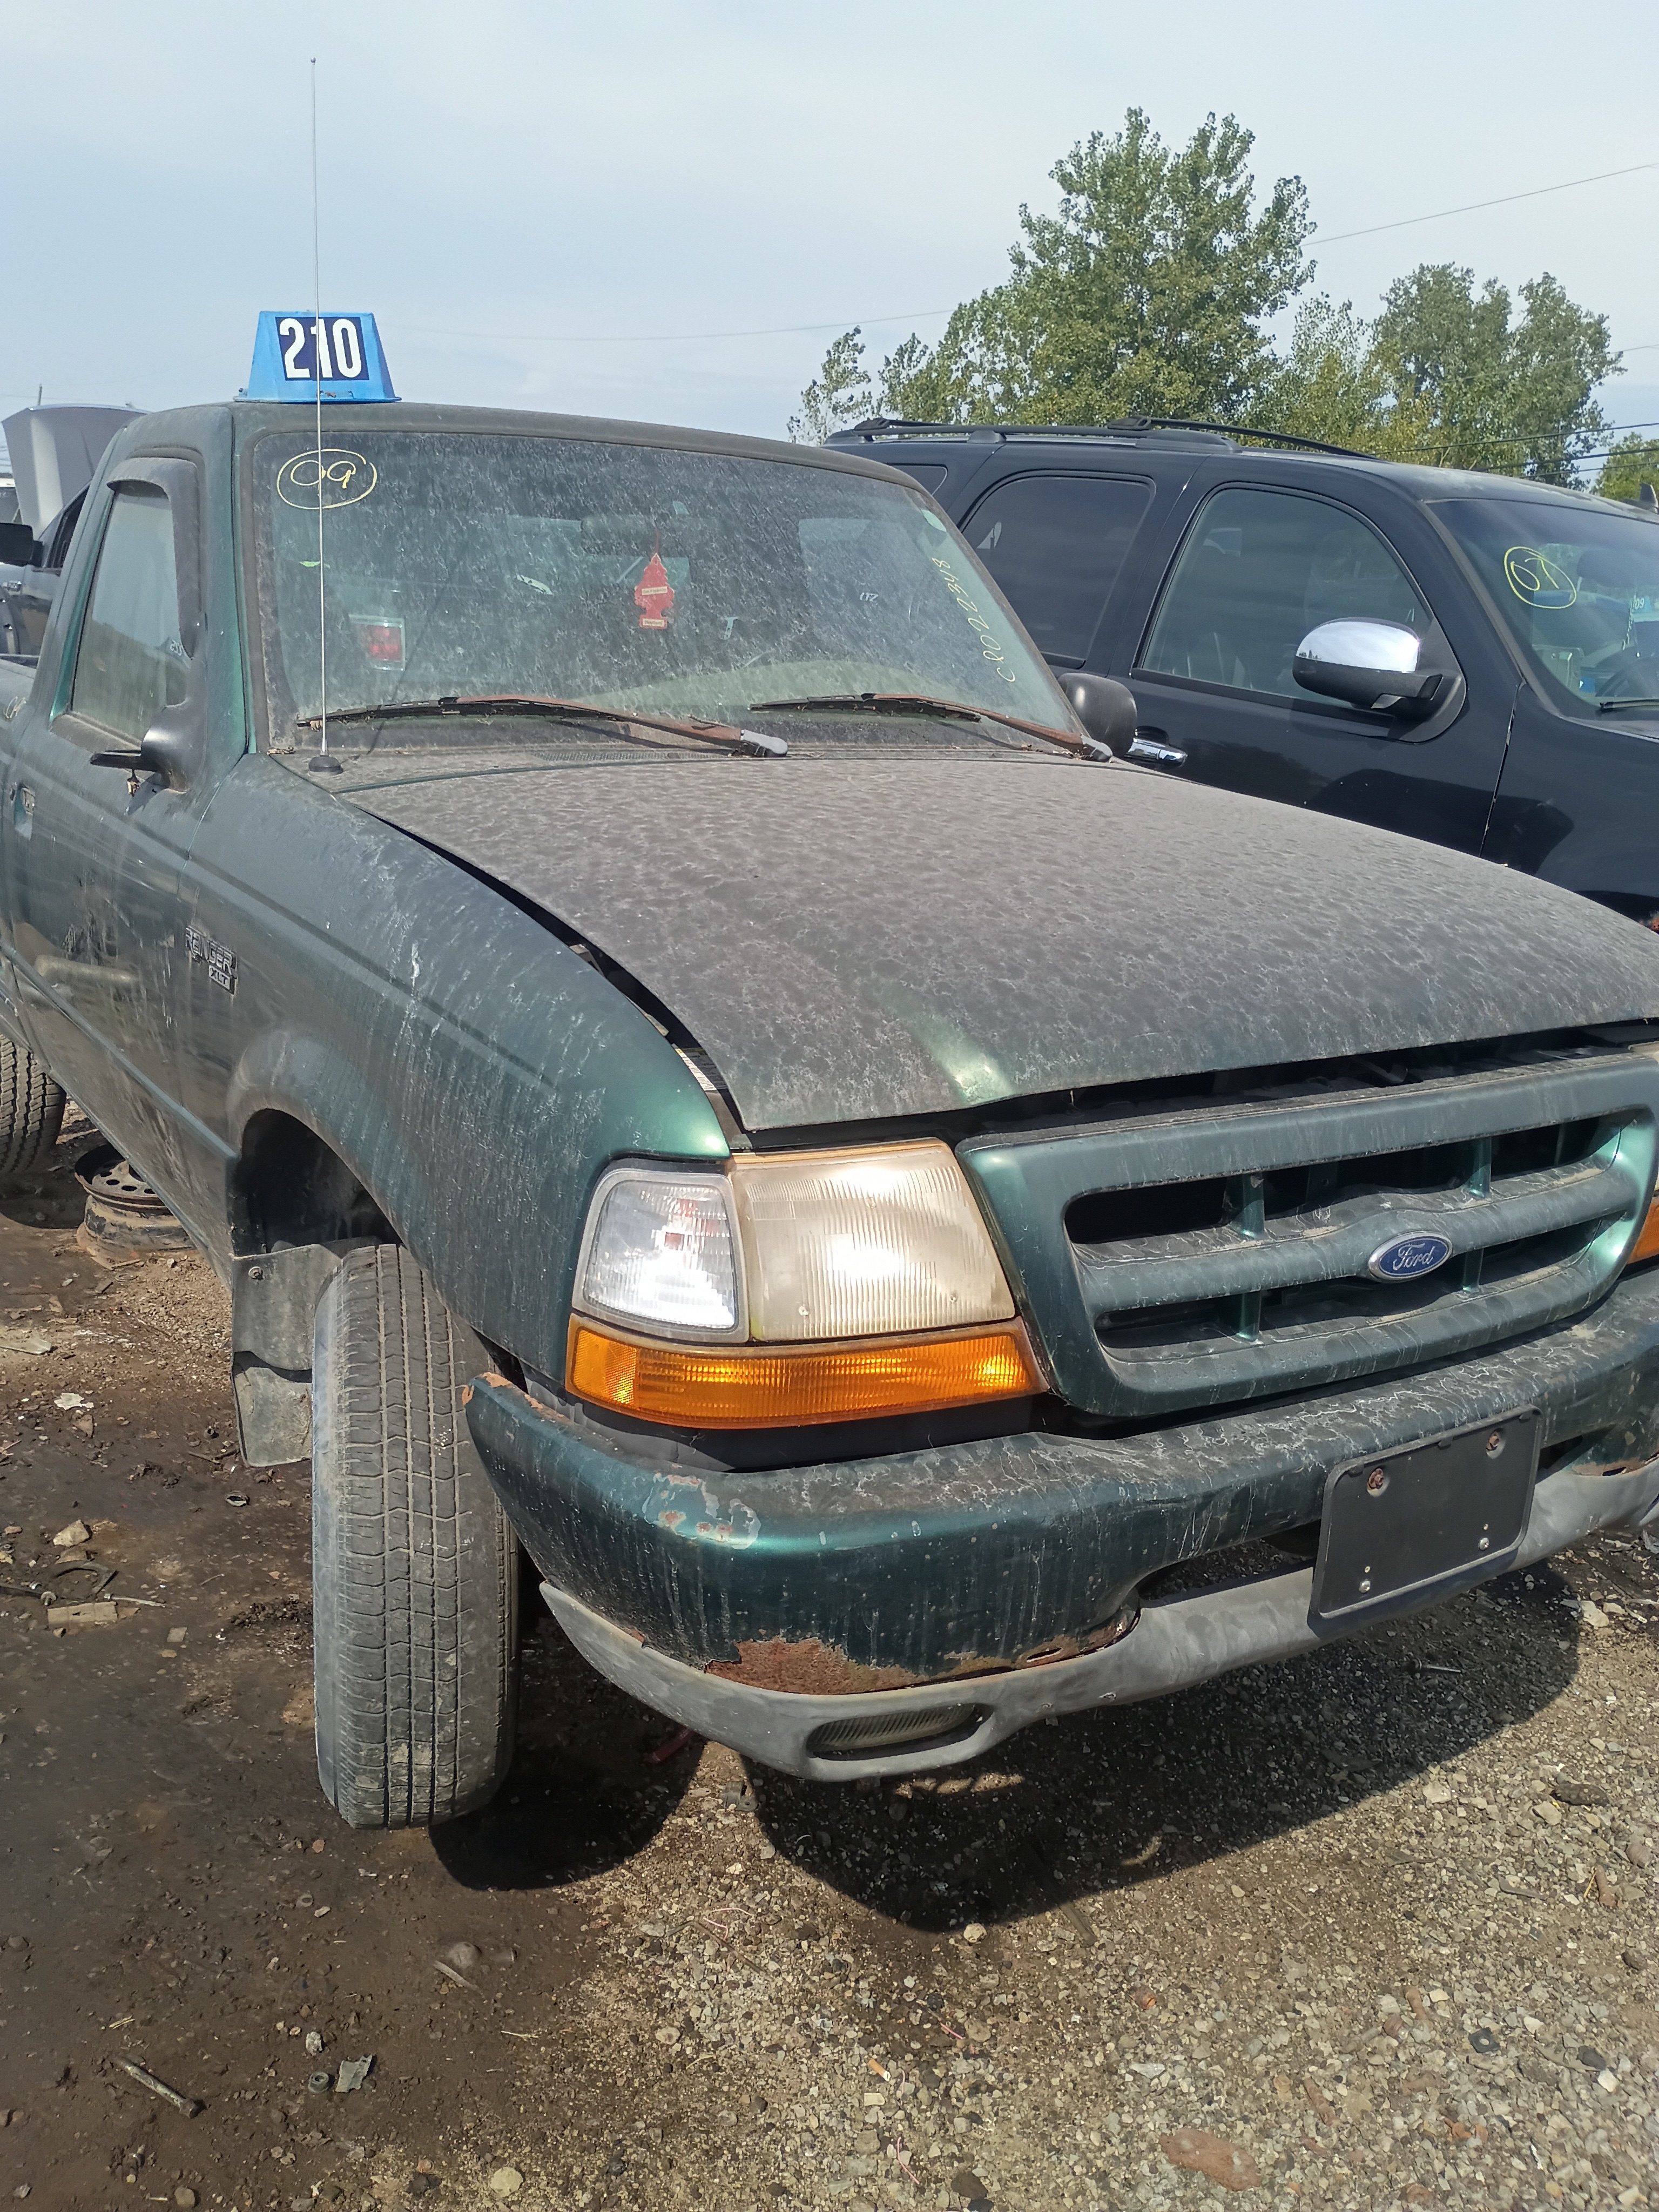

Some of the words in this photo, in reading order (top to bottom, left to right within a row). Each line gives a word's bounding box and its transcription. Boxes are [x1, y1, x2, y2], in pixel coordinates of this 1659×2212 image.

[279, 318, 362, 379] 210
[185, 927, 233, 975] RANGER
[210, 967, 228, 985] XLT
[1392, 1243, 1435, 1271] Ford
